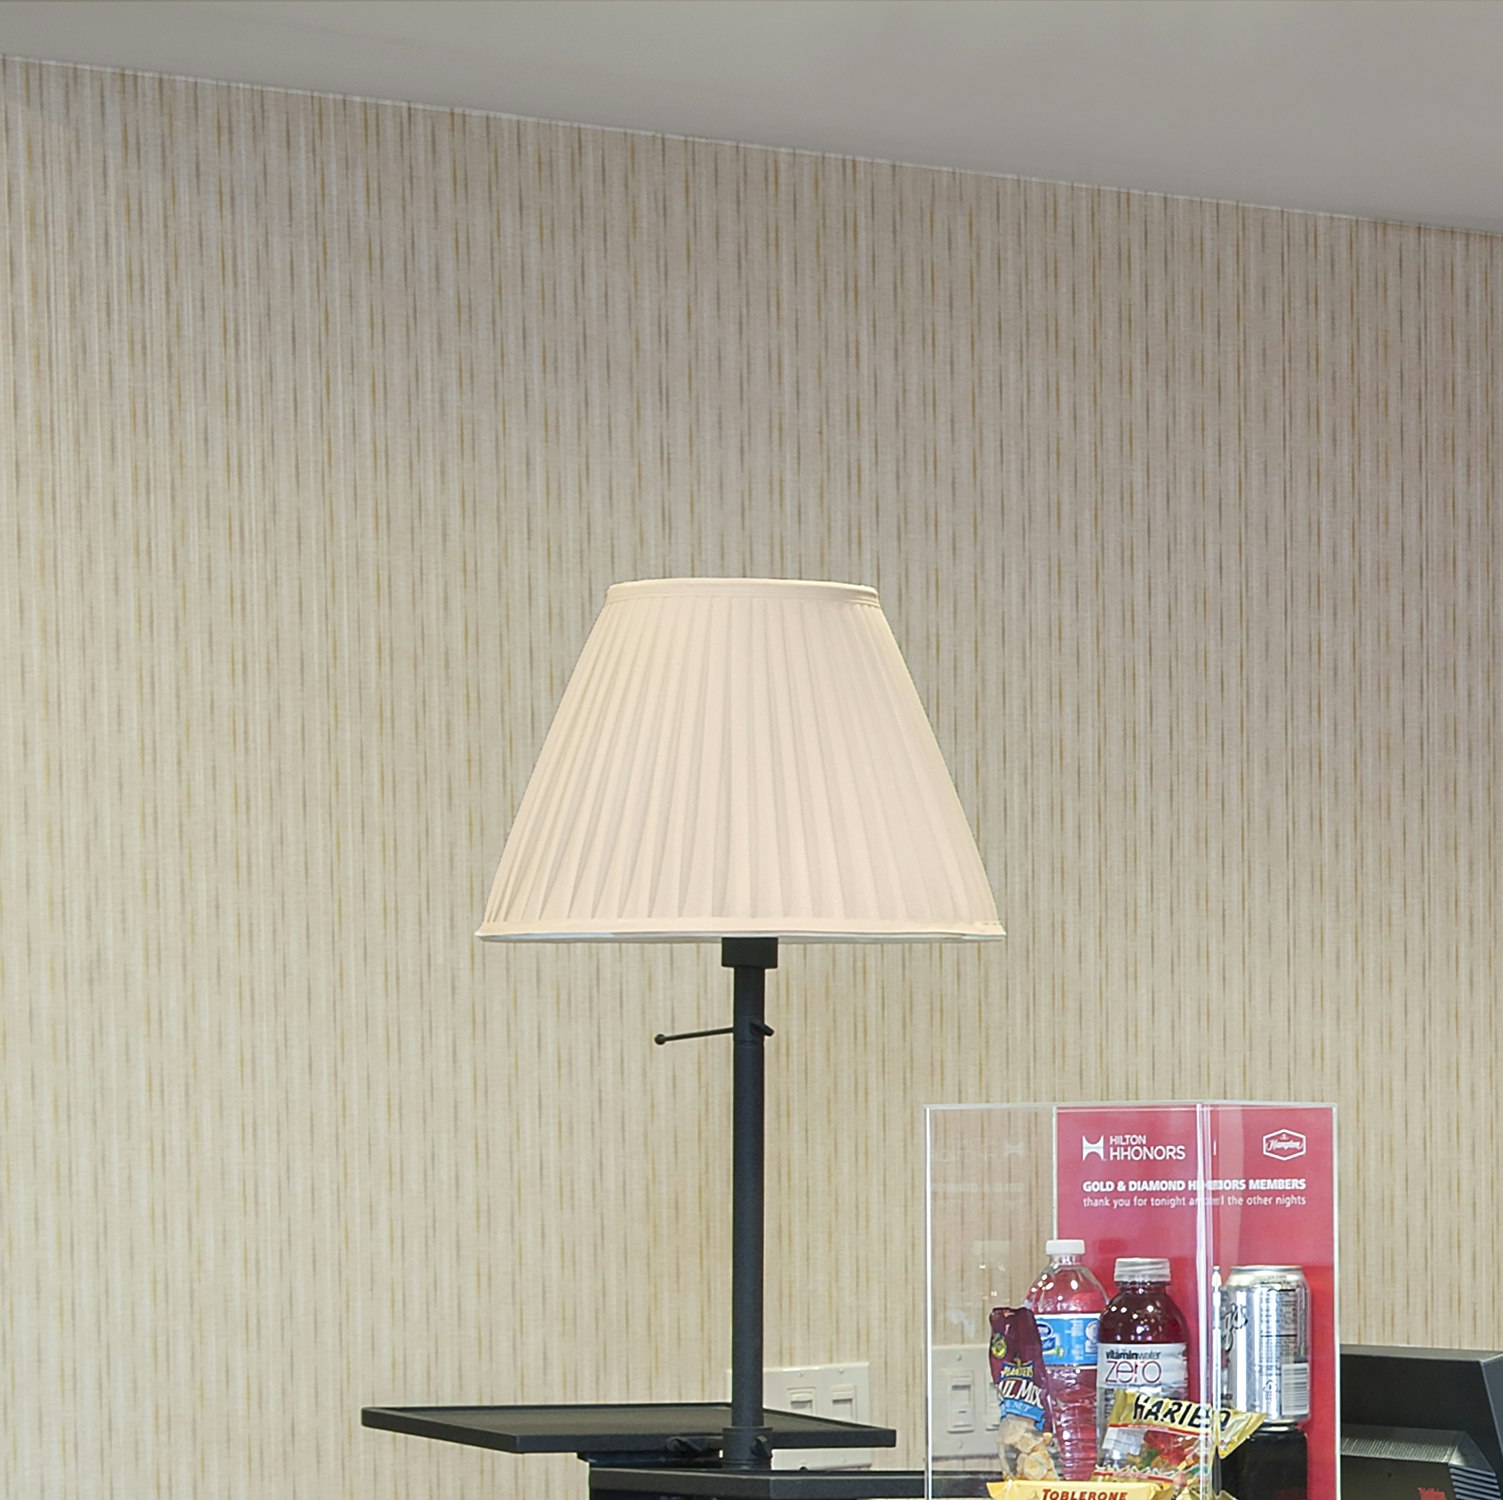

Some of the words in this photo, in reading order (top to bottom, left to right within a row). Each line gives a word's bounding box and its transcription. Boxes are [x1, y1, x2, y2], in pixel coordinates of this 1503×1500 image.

[1109, 1135, 1147, 1145] HILTON
[1109, 1146, 1186, 1161] HHONORS
[1082, 1180, 1115, 1192] GOLD
[1117, 1180, 1126, 1192] &
[1128, 1180, 1186, 1191] DIAMOND
[1248, 1178, 1307, 1190] MEMBERS
[1083, 1197, 1110, 1207] thank
[1113, 1200, 1131, 1209] you
[1133, 1196, 1147, 1206] for
[1150, 1196, 1186, 1208] tonight
[1227, 1195, 1244, 1206] the
[1246, 1195, 1273, 1206] other
[1275, 1194, 1307, 1207] nights
[1105, 1360, 1162, 1384] zero
[1015, 1379, 1044, 1409] MIX
